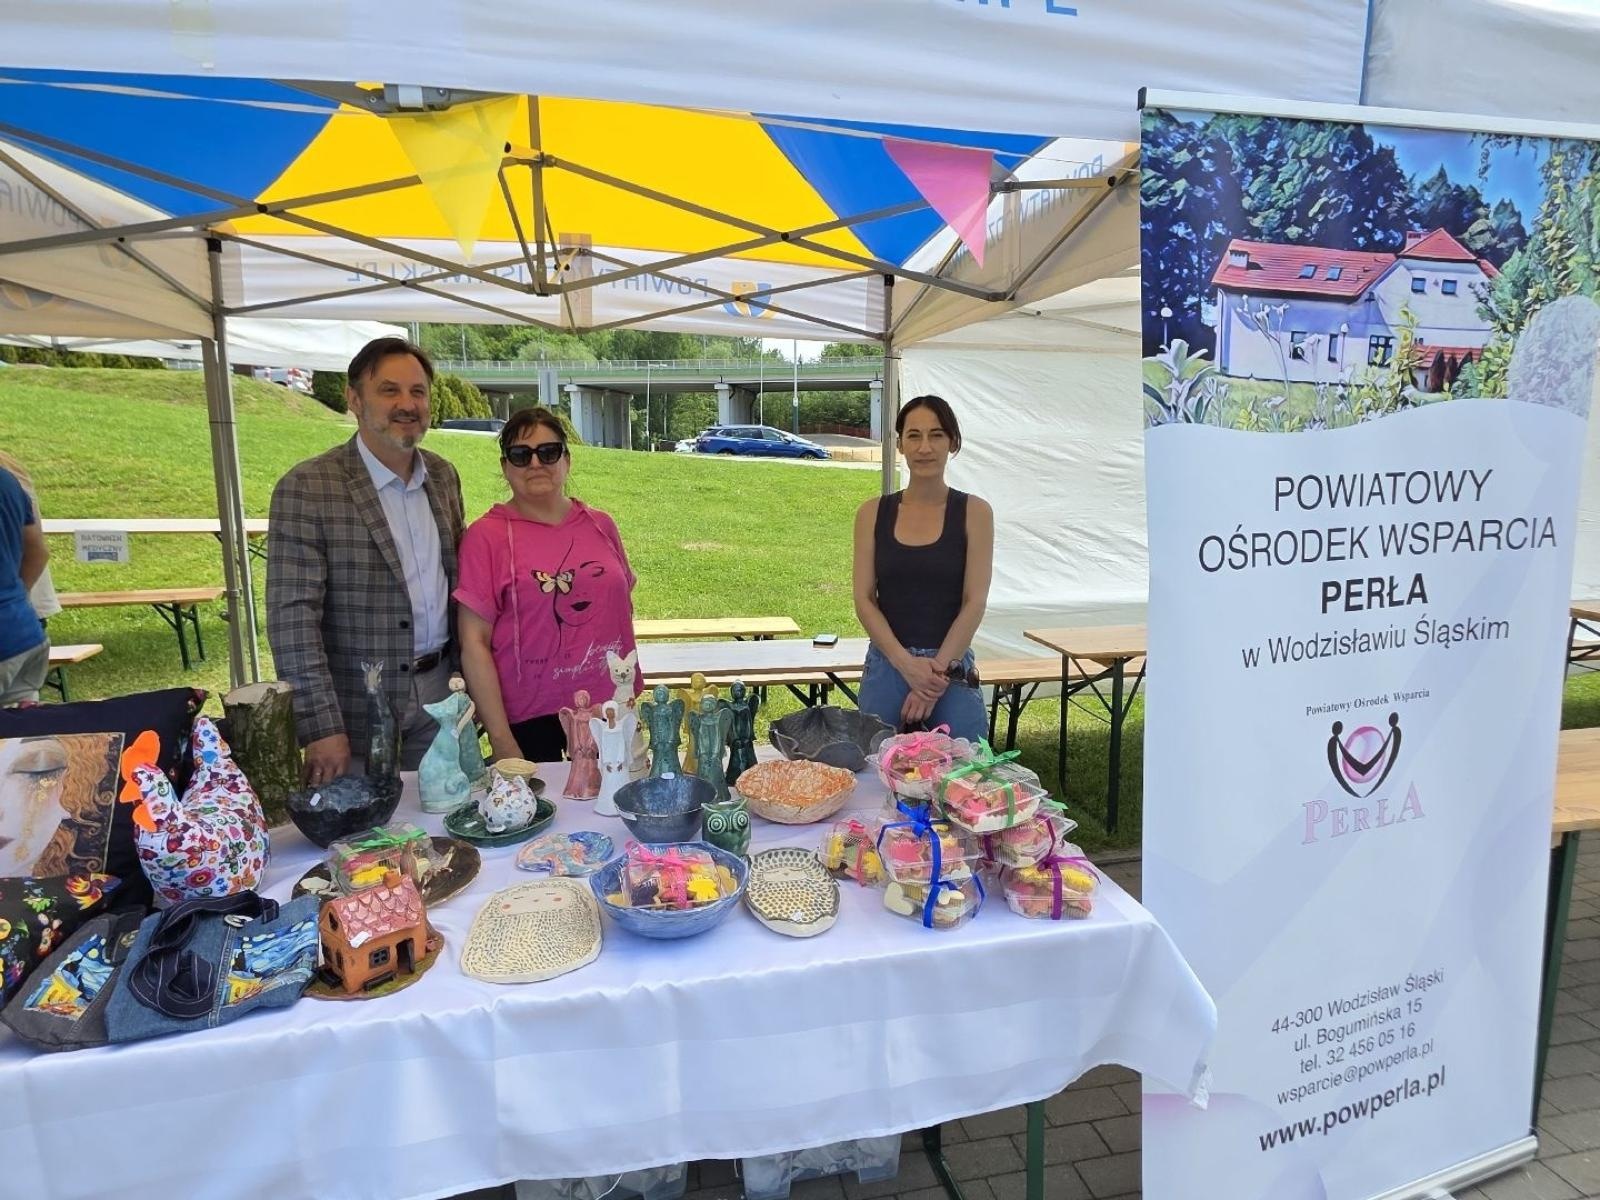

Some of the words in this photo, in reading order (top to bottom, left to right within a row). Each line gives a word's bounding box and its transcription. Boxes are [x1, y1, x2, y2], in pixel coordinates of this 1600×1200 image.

[1275, 469, 1493, 511] POWIATOWY
[1199, 524, 1369, 572] OŚRODEK
[1379, 516, 1557, 557] WSPARCIA
[1321, 573, 1428, 613] PERŁA
[1242, 647, 1260, 668] w
[1268, 624, 1406, 664] Wodzisławiu
[1414, 614, 1509, 649] Śląskim
[1306, 702, 1350, 716] Powiatowy
[1354, 694, 1389, 708] Ośrodek
[1393, 688, 1430, 702] Wsparcia
[1271, 1006, 1323, 1034] 44-300
[1328, 984, 1400, 1017] Wodzisław
[1404, 968, 1444, 992] Śląski
[1294, 1034, 1311, 1051] ul.
[1317, 1006, 1401, 1045] Bogumińska
[1406, 998, 1422, 1014] 15
[1277, 1038, 1433, 1105] wsparcie@powperla.pl
[1300, 1057, 1321, 1073] tel.
[1326, 1046, 1344, 1066] 32
[1349, 1036, 1374, 1056] 456
[1379, 1029, 1394, 1048] 05
[1401, 1022, 1416, 1038] 16
[1259, 1065, 1446, 1151] www.powperla.pl
